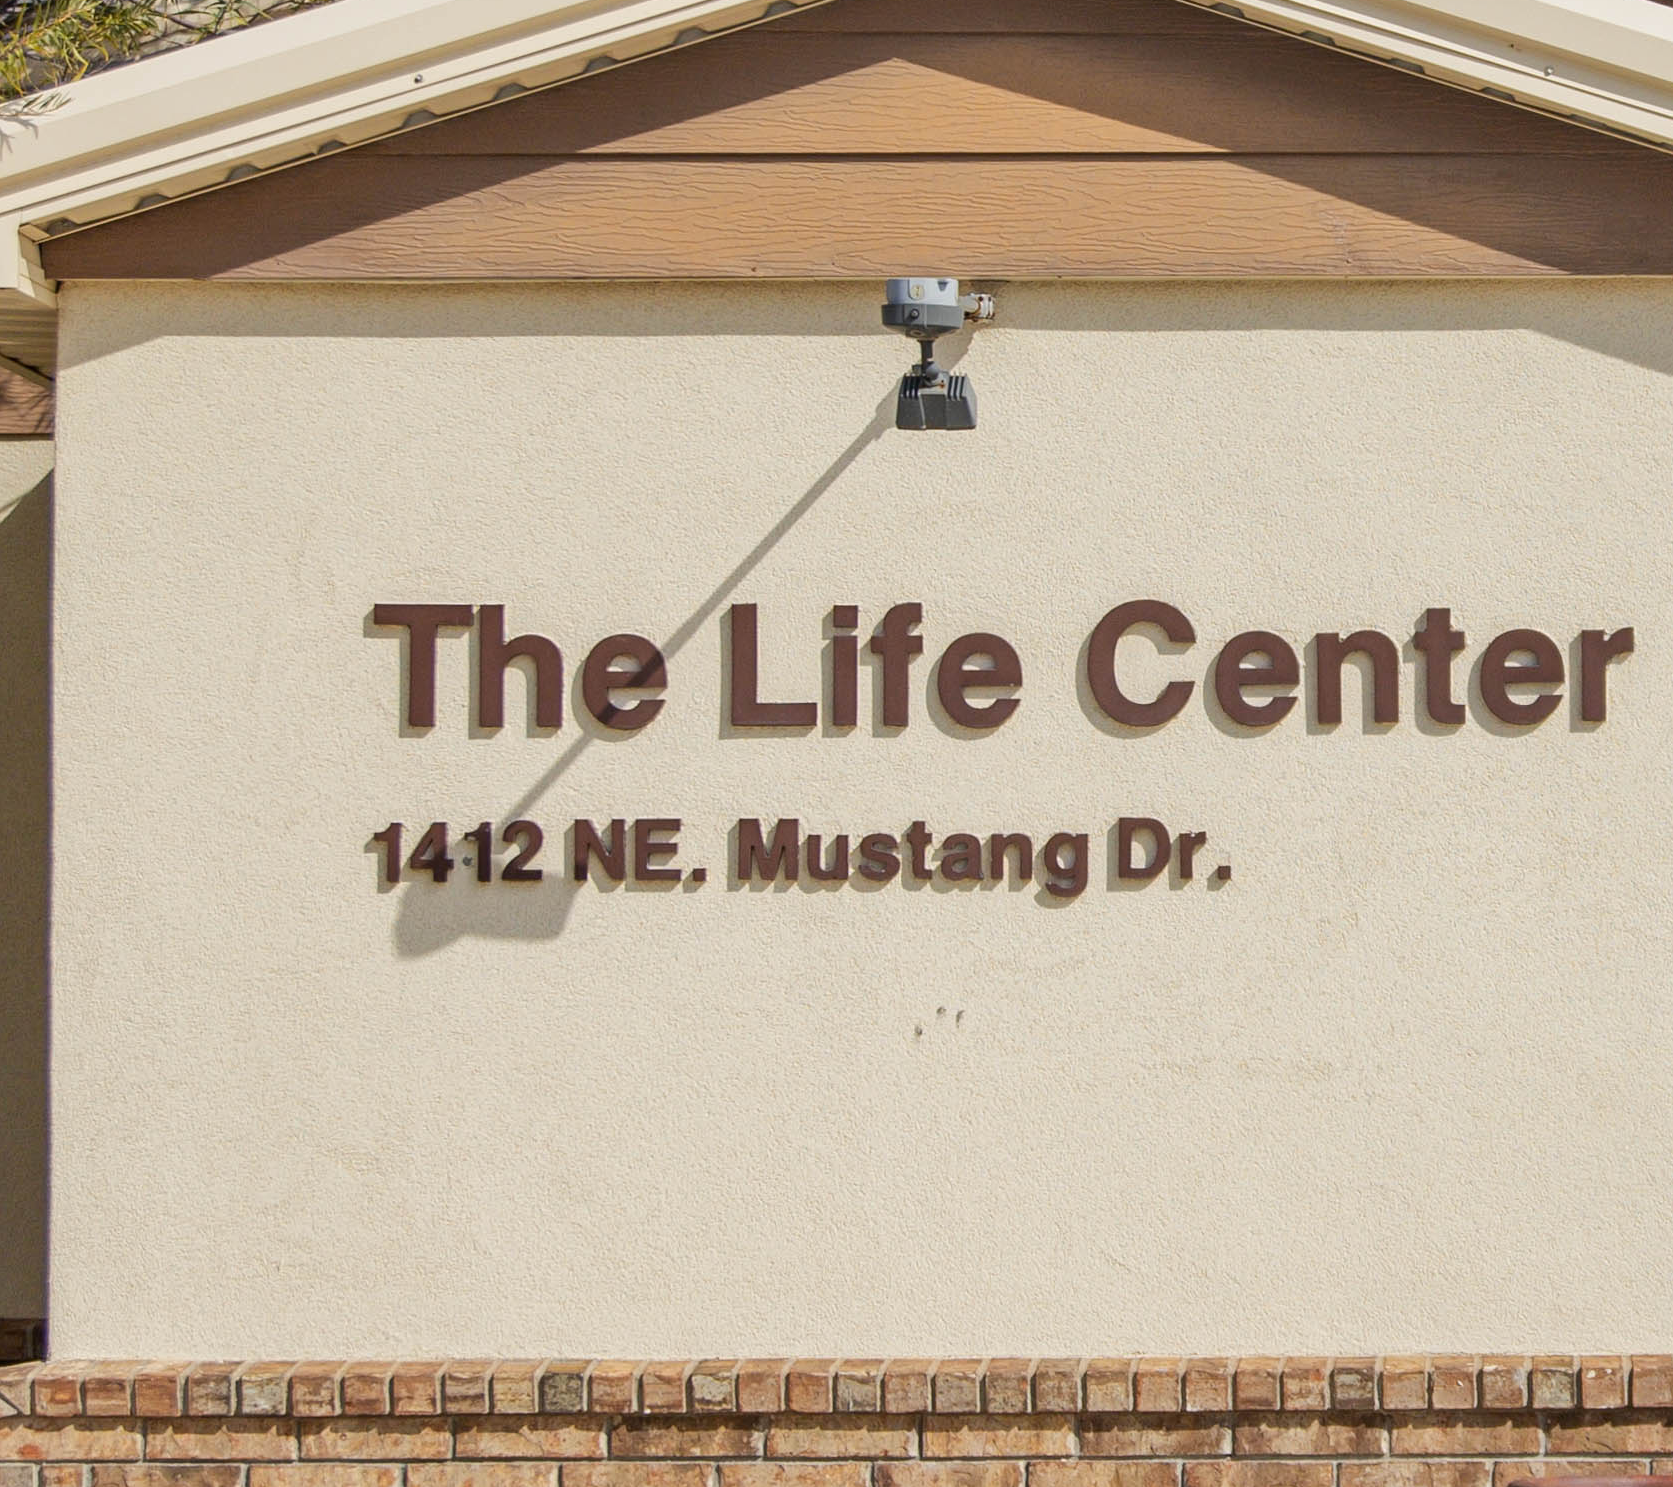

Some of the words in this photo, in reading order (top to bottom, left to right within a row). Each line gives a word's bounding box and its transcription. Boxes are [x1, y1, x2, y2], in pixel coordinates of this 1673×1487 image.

[373, 603, 668, 730] The
[729, 602, 1022, 729] Life
[1085, 599, 1635, 727] Center
[372, 820, 544, 883] 1412
[573, 819, 706, 882] NE.
[737, 818, 1089, 898] Mustang
[1118, 817, 1231, 881] Dr.
